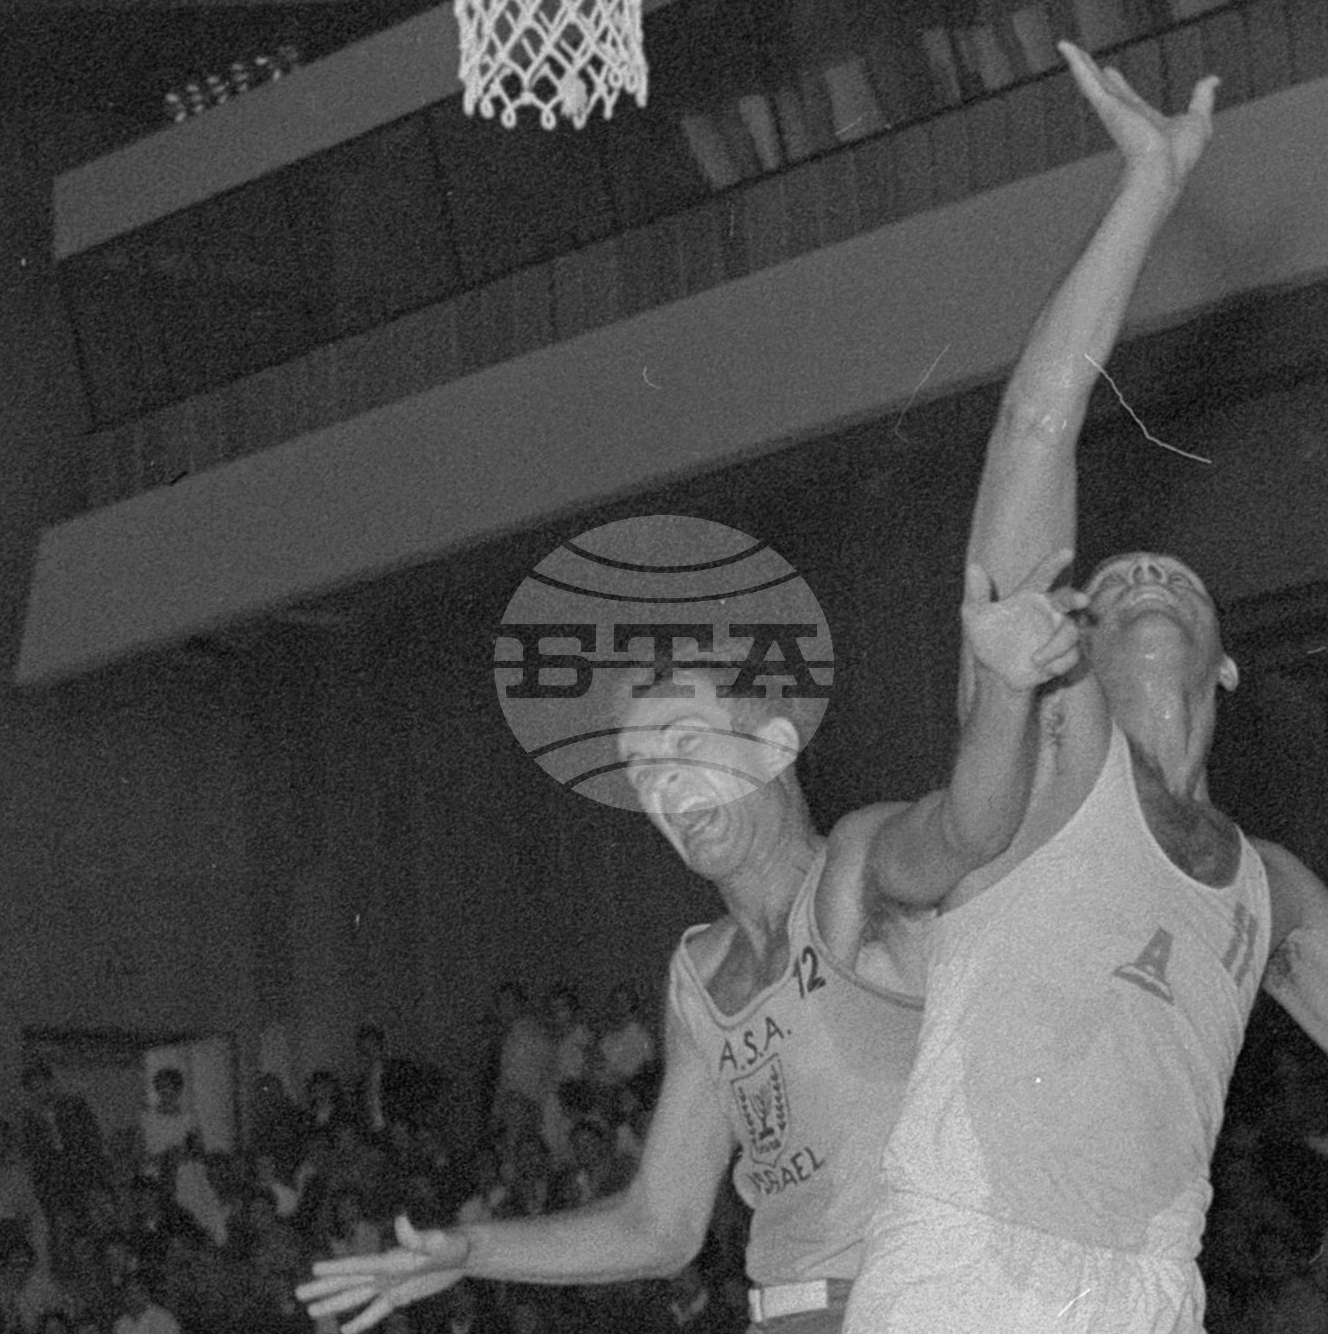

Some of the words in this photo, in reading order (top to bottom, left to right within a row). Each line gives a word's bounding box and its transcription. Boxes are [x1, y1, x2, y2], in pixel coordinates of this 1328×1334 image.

[792, 945, 826, 999] 12
[719, 1016, 792, 1071] A.S.A.
[746, 1146, 824, 1195] ISRAEL
